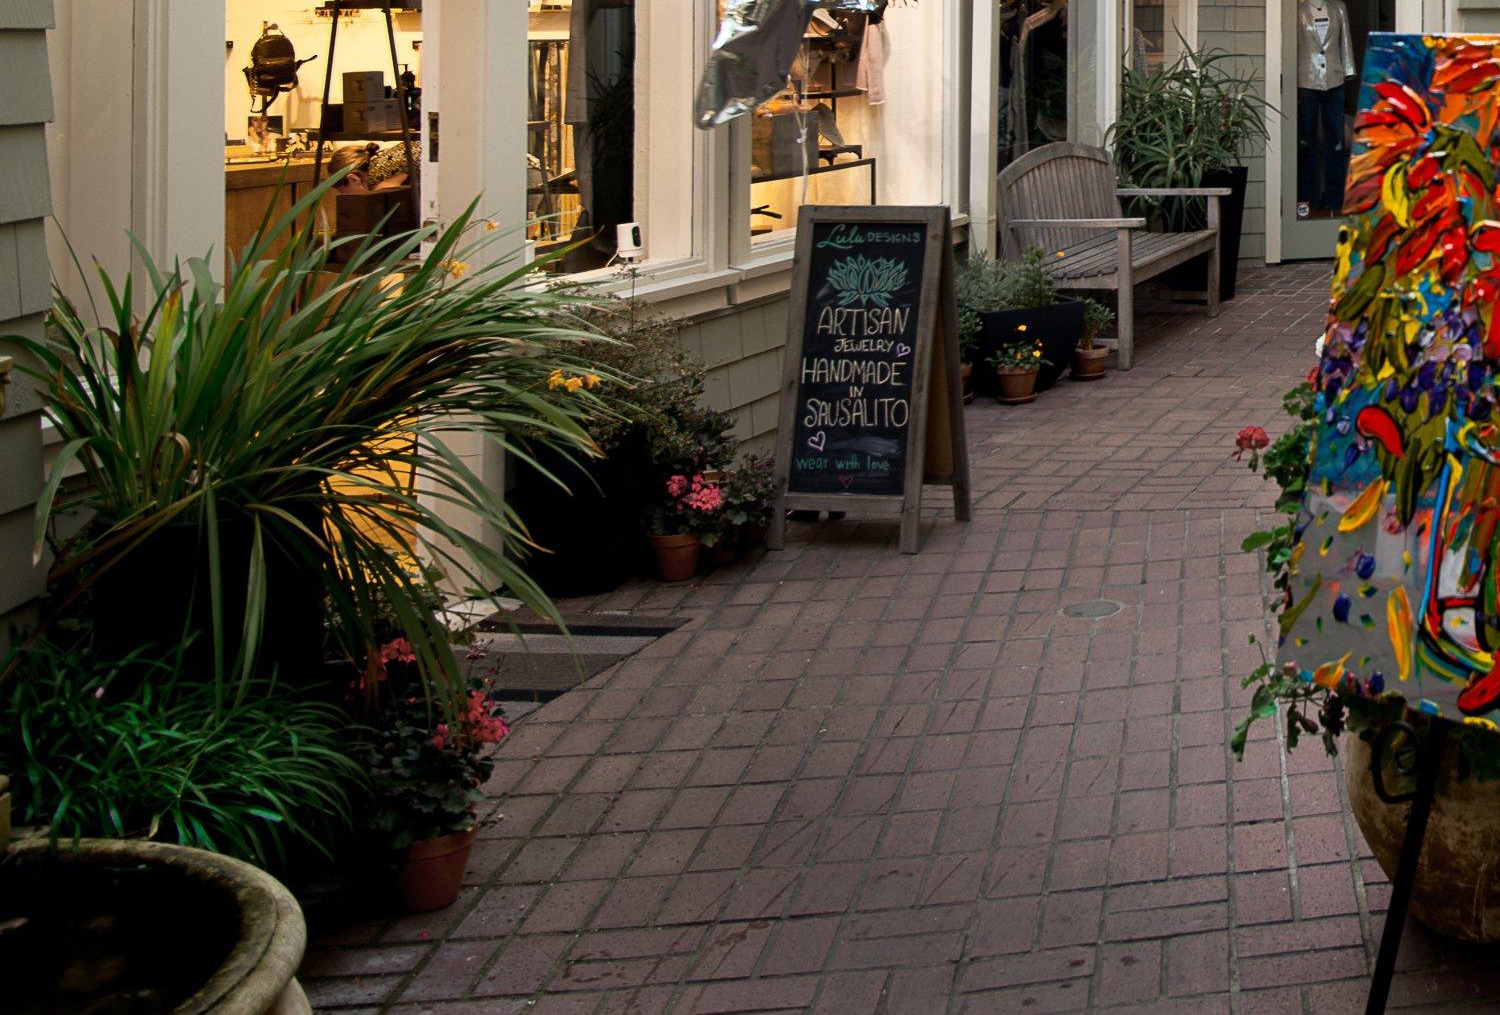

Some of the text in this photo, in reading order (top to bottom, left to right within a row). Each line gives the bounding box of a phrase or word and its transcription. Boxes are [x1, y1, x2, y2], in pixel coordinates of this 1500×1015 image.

[816, 224, 921, 250] Lulu DESIGNS
[816, 306, 910, 335] ARTISAN
[834, 337, 895, 353] JEWELRY
[801, 357, 907, 387] HANDMADE
[849, 386, 865, 399] IN
[804, 398, 910, 428] SAUSALITO
[796, 456, 829, 471] wear
[835, 455, 861, 471] with
